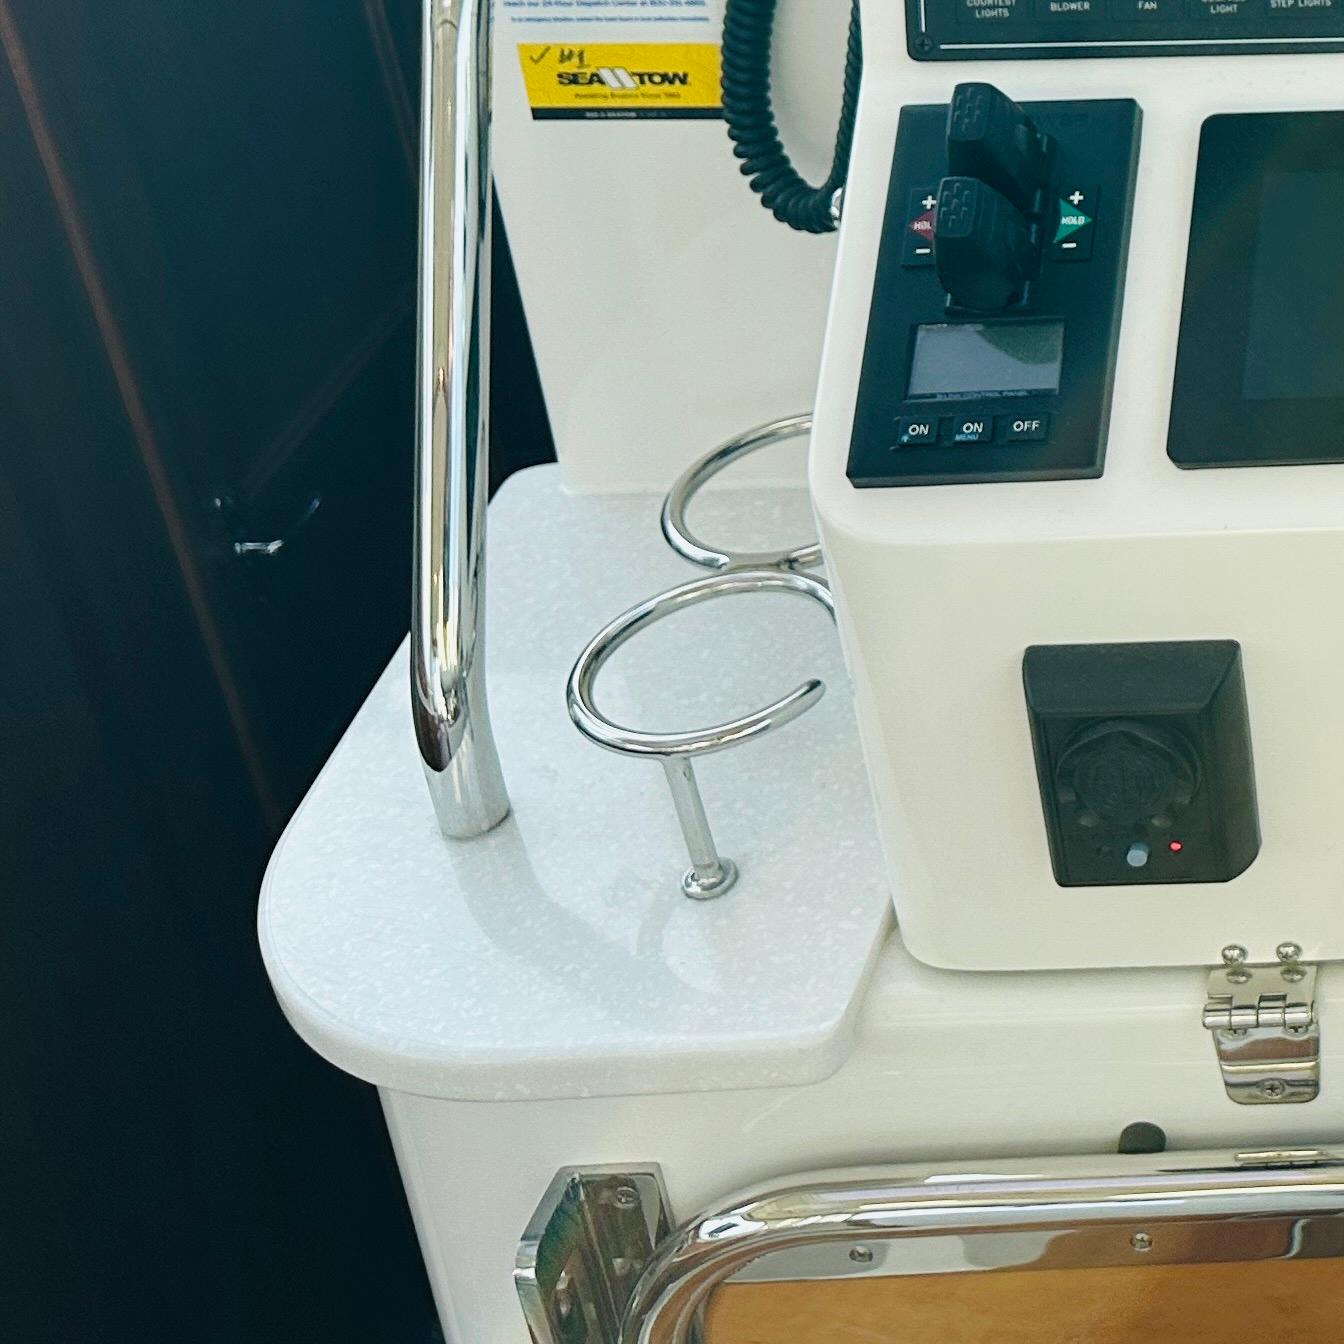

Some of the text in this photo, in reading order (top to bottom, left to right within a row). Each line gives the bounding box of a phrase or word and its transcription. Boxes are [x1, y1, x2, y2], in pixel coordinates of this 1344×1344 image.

[1050, 1, 1091, 12] BLOWER
[1137, 1, 1158, 10] FAN
[1209, 3, 1239, 14] LIGHT
[975, 8, 1010, 18] LIGHTS
[556, 71, 689, 86] SEA TOW
[913, 220, 933, 231] HOL
[1060, 215, 1086, 226] HOLD
[908, 423, 930, 436] ON
[962, 422, 984, 434] ON
[1013, 420, 1041, 432] OFF
[954, 433, 979, 442] MENU
